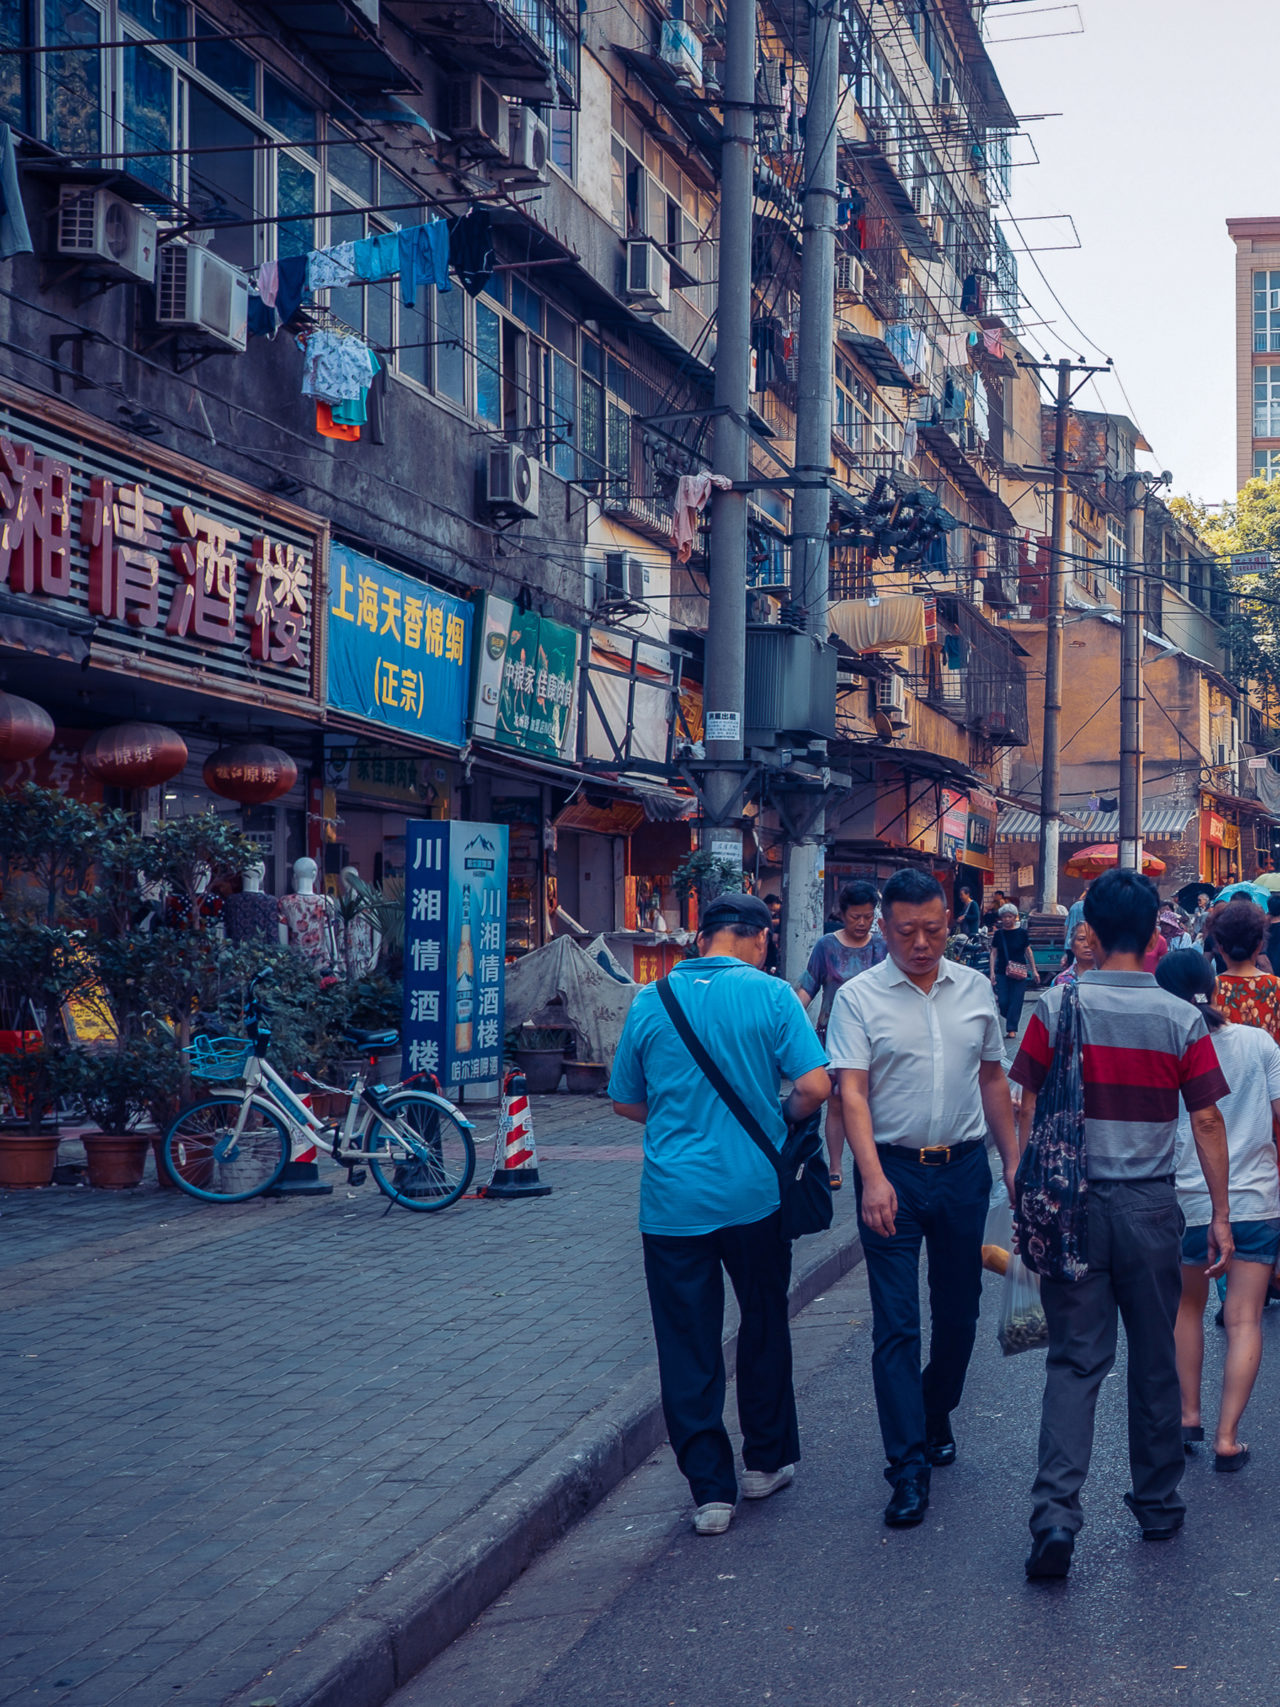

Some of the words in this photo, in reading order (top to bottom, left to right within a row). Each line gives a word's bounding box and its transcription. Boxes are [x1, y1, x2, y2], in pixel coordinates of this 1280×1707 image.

[0, 434, 310, 668] 湘情酒楼
[331, 564, 465, 667] 上海天香棉绸
[374, 656, 425, 719] (正宗)
[409, 838, 442, 1072] 川湘情酒楼
[477, 888, 502, 1049] 川湘情酒楼
[451, 1056, 499, 1081] 哈尔滨啤酒
